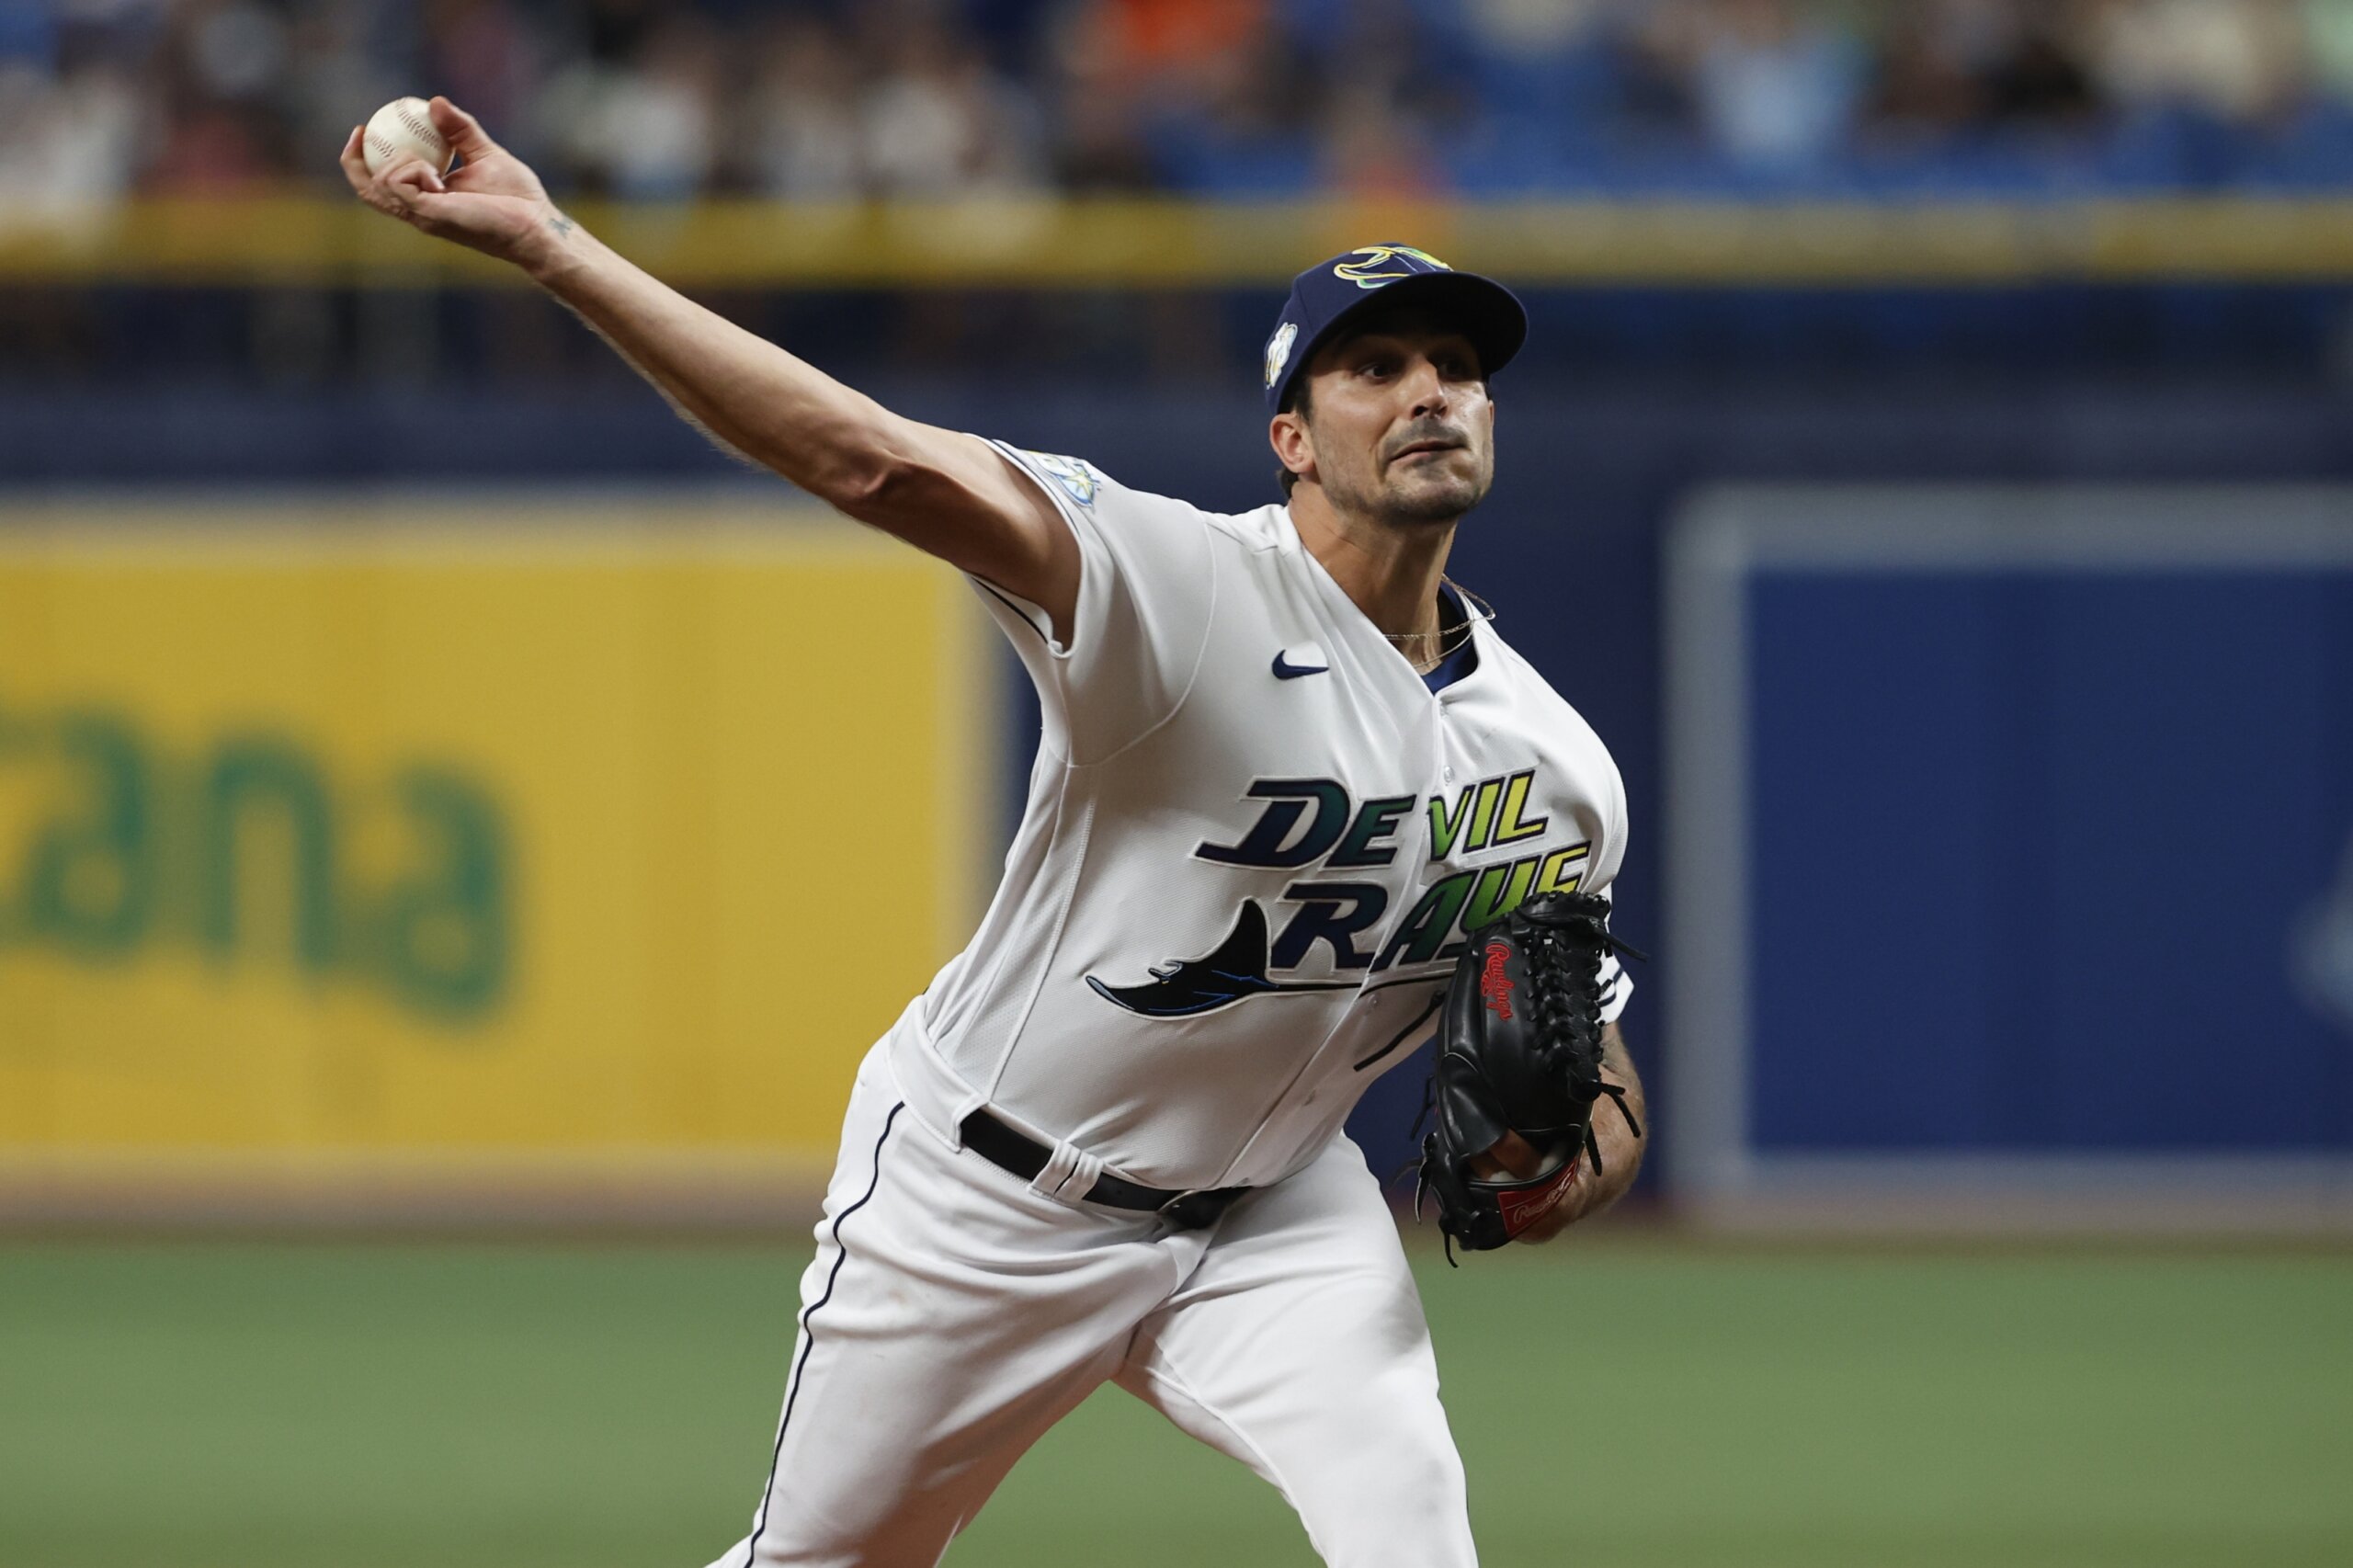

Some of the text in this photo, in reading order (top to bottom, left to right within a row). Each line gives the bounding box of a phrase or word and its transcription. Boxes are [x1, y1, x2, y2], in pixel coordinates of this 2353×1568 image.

[0, 704, 518, 1024] ana
[1193, 769, 1549, 869] DEVIL
[1481, 942, 1516, 1021] Rawlings
